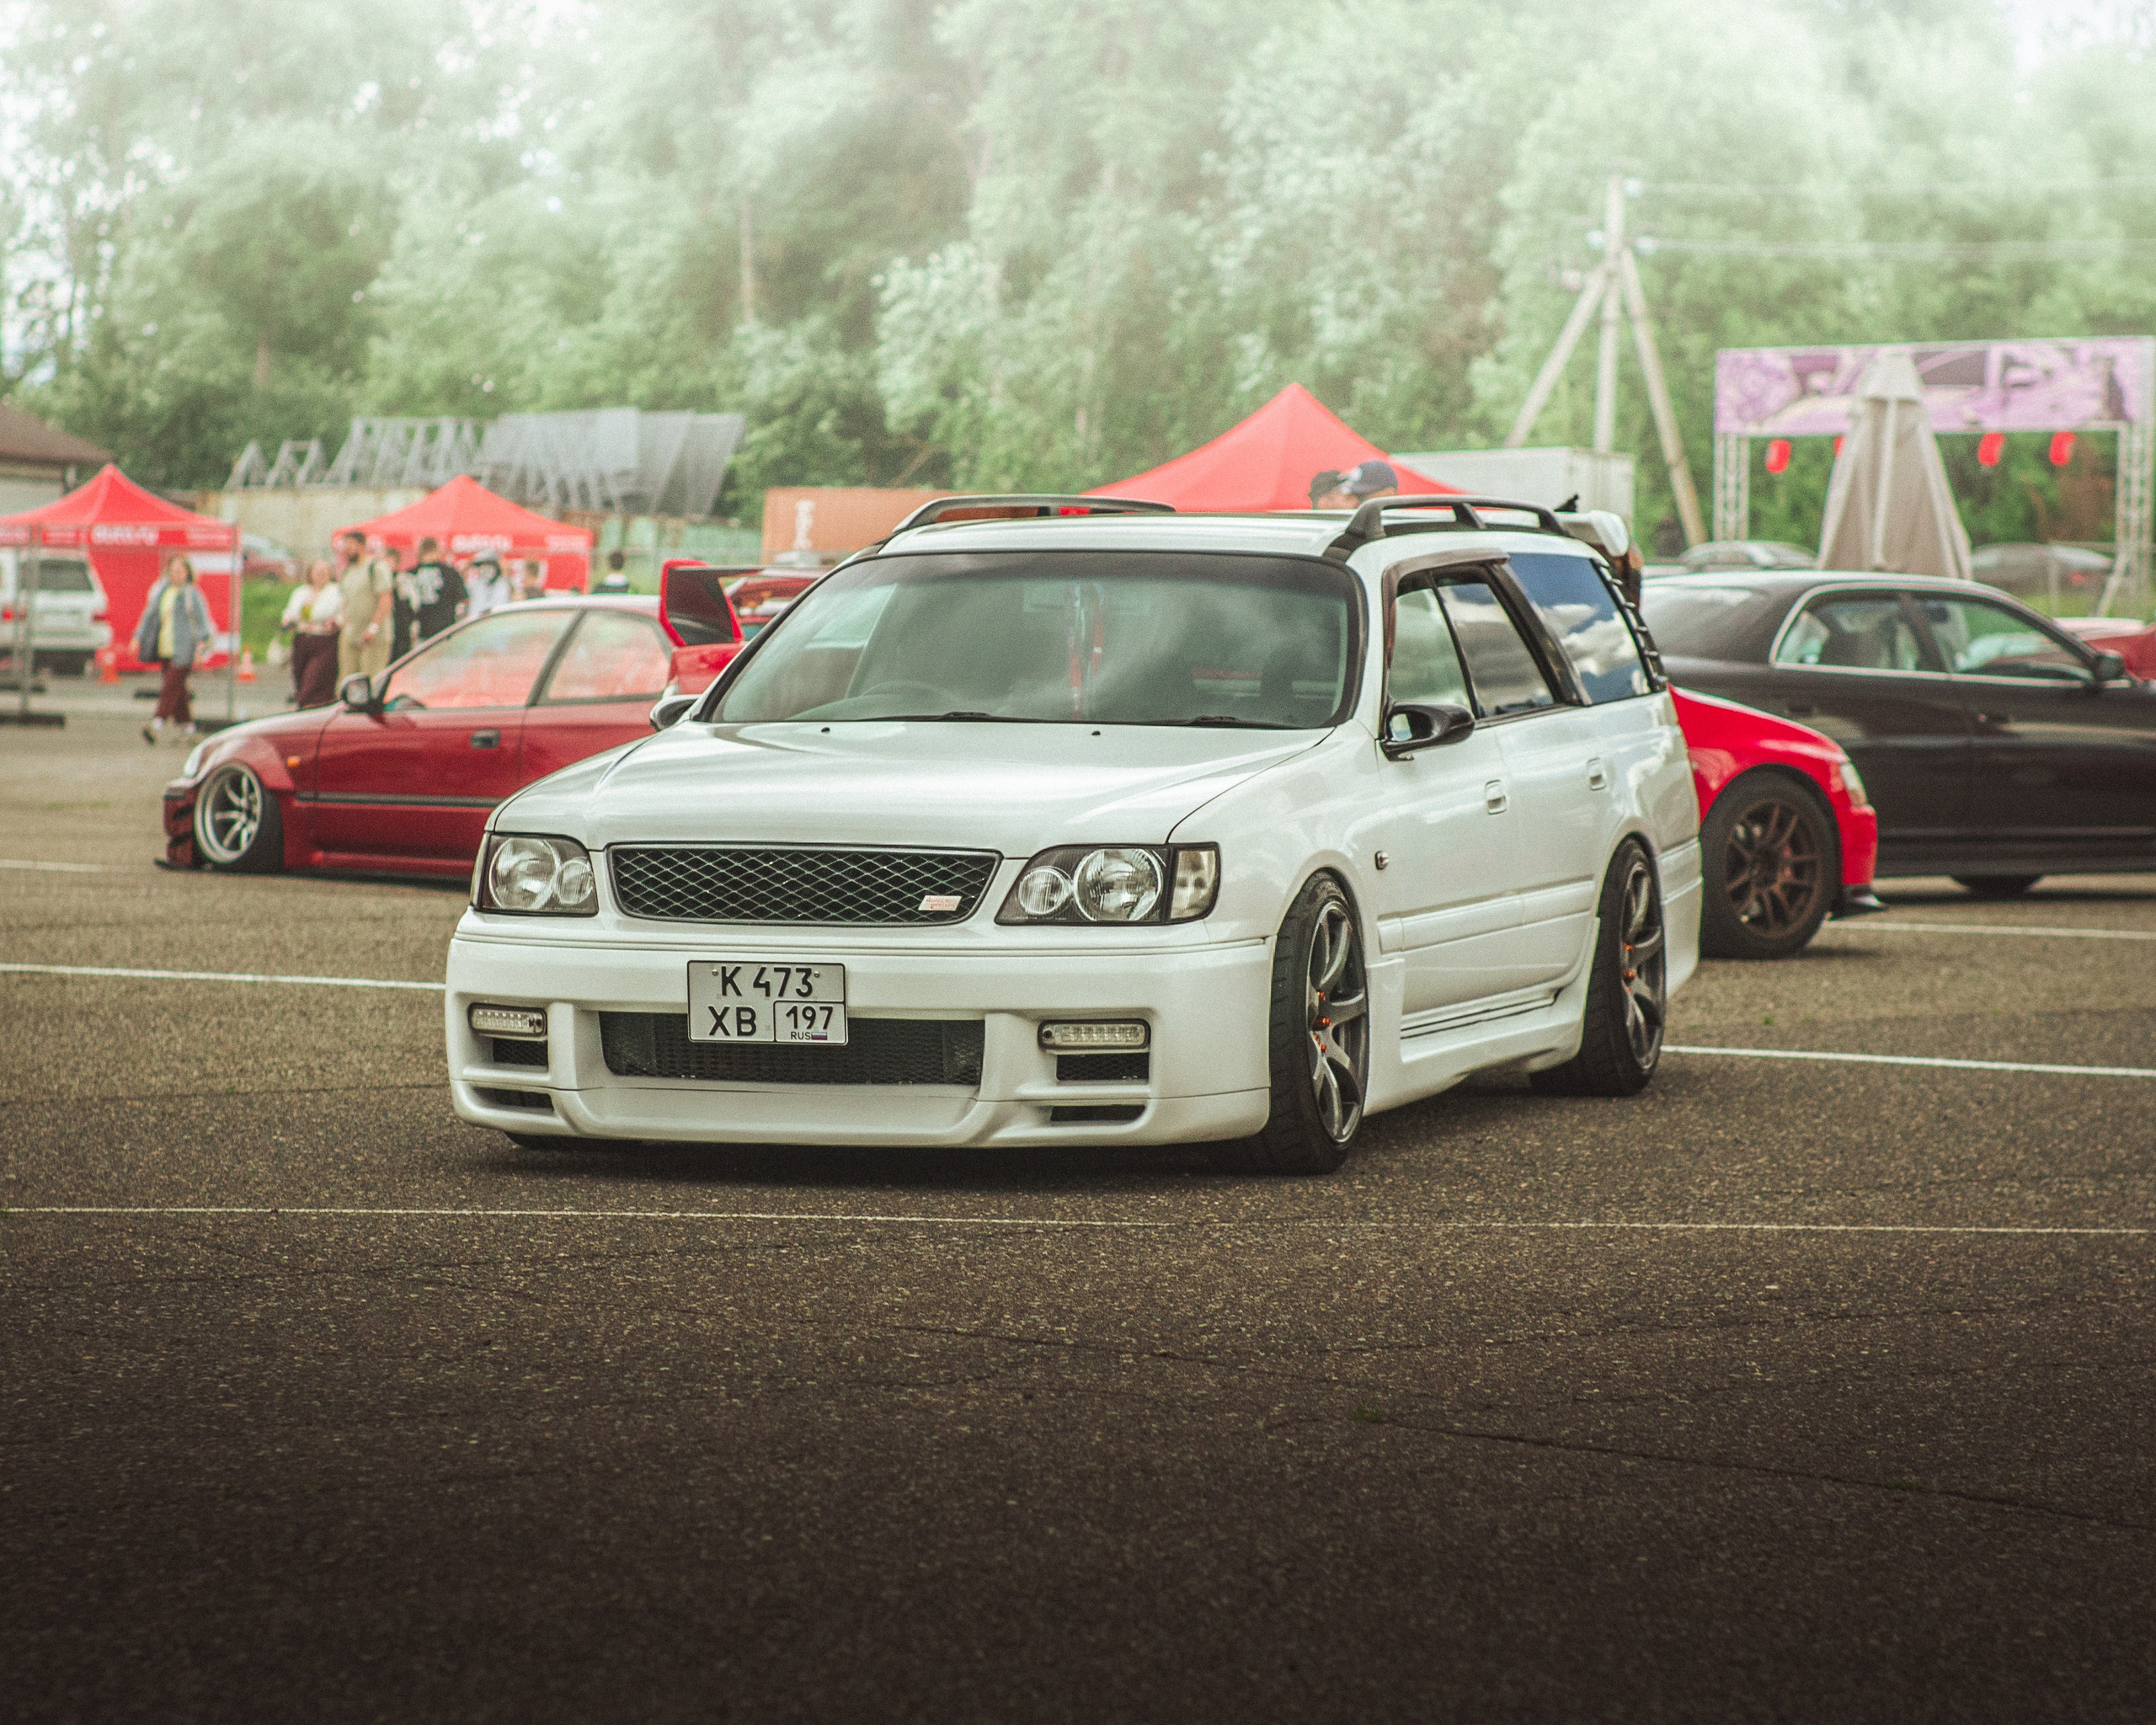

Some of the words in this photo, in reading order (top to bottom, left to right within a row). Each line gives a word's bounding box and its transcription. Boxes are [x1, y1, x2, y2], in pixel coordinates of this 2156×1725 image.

[753, 967, 813, 997] 473
[708, 1006, 757, 1037] XB
[786, 1006, 834, 1030] 197
[790, 1031, 811, 1040] RUS
